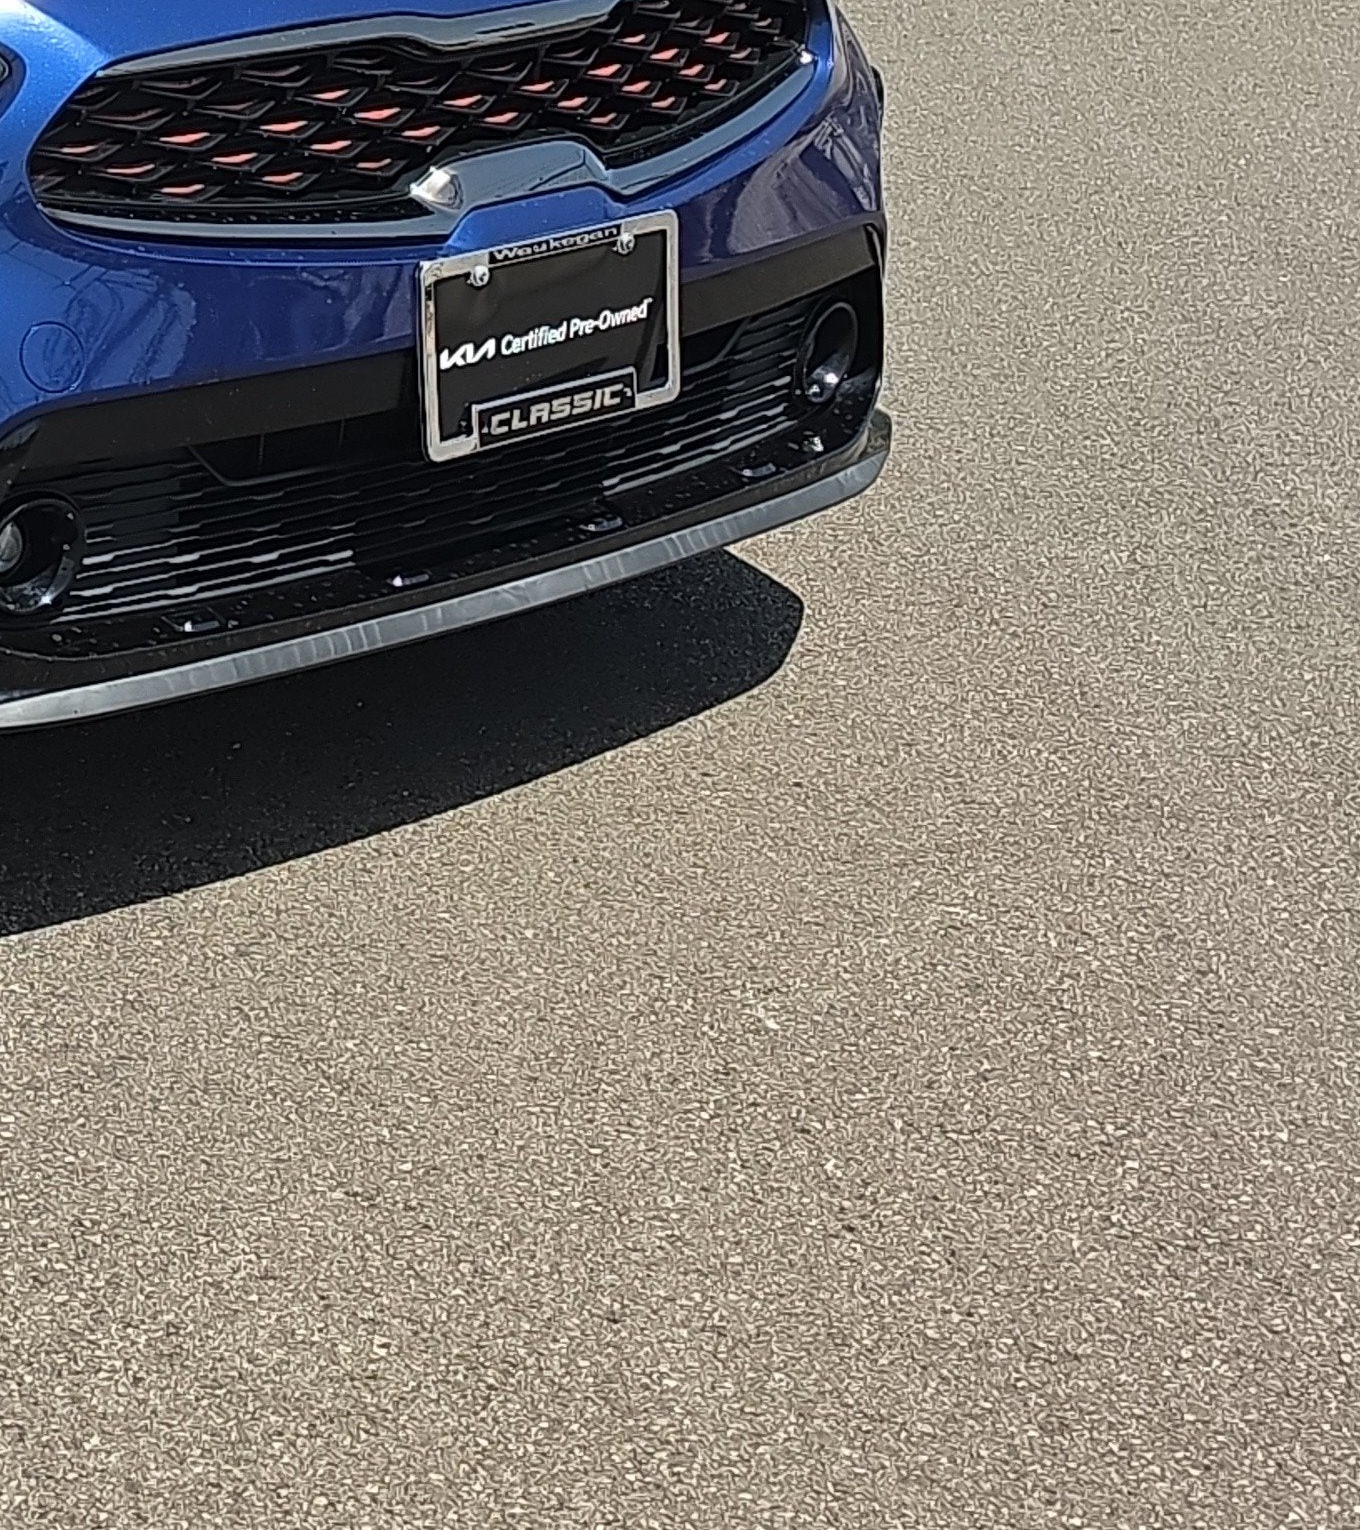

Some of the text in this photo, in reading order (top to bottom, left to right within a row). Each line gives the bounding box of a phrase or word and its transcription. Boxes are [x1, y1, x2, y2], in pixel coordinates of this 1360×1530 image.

[493, 227, 618, 261] Waukegan
[439, 303, 648, 370] KIA Certified Pre-Owned
[490, 383, 624, 435] CLASSIC
